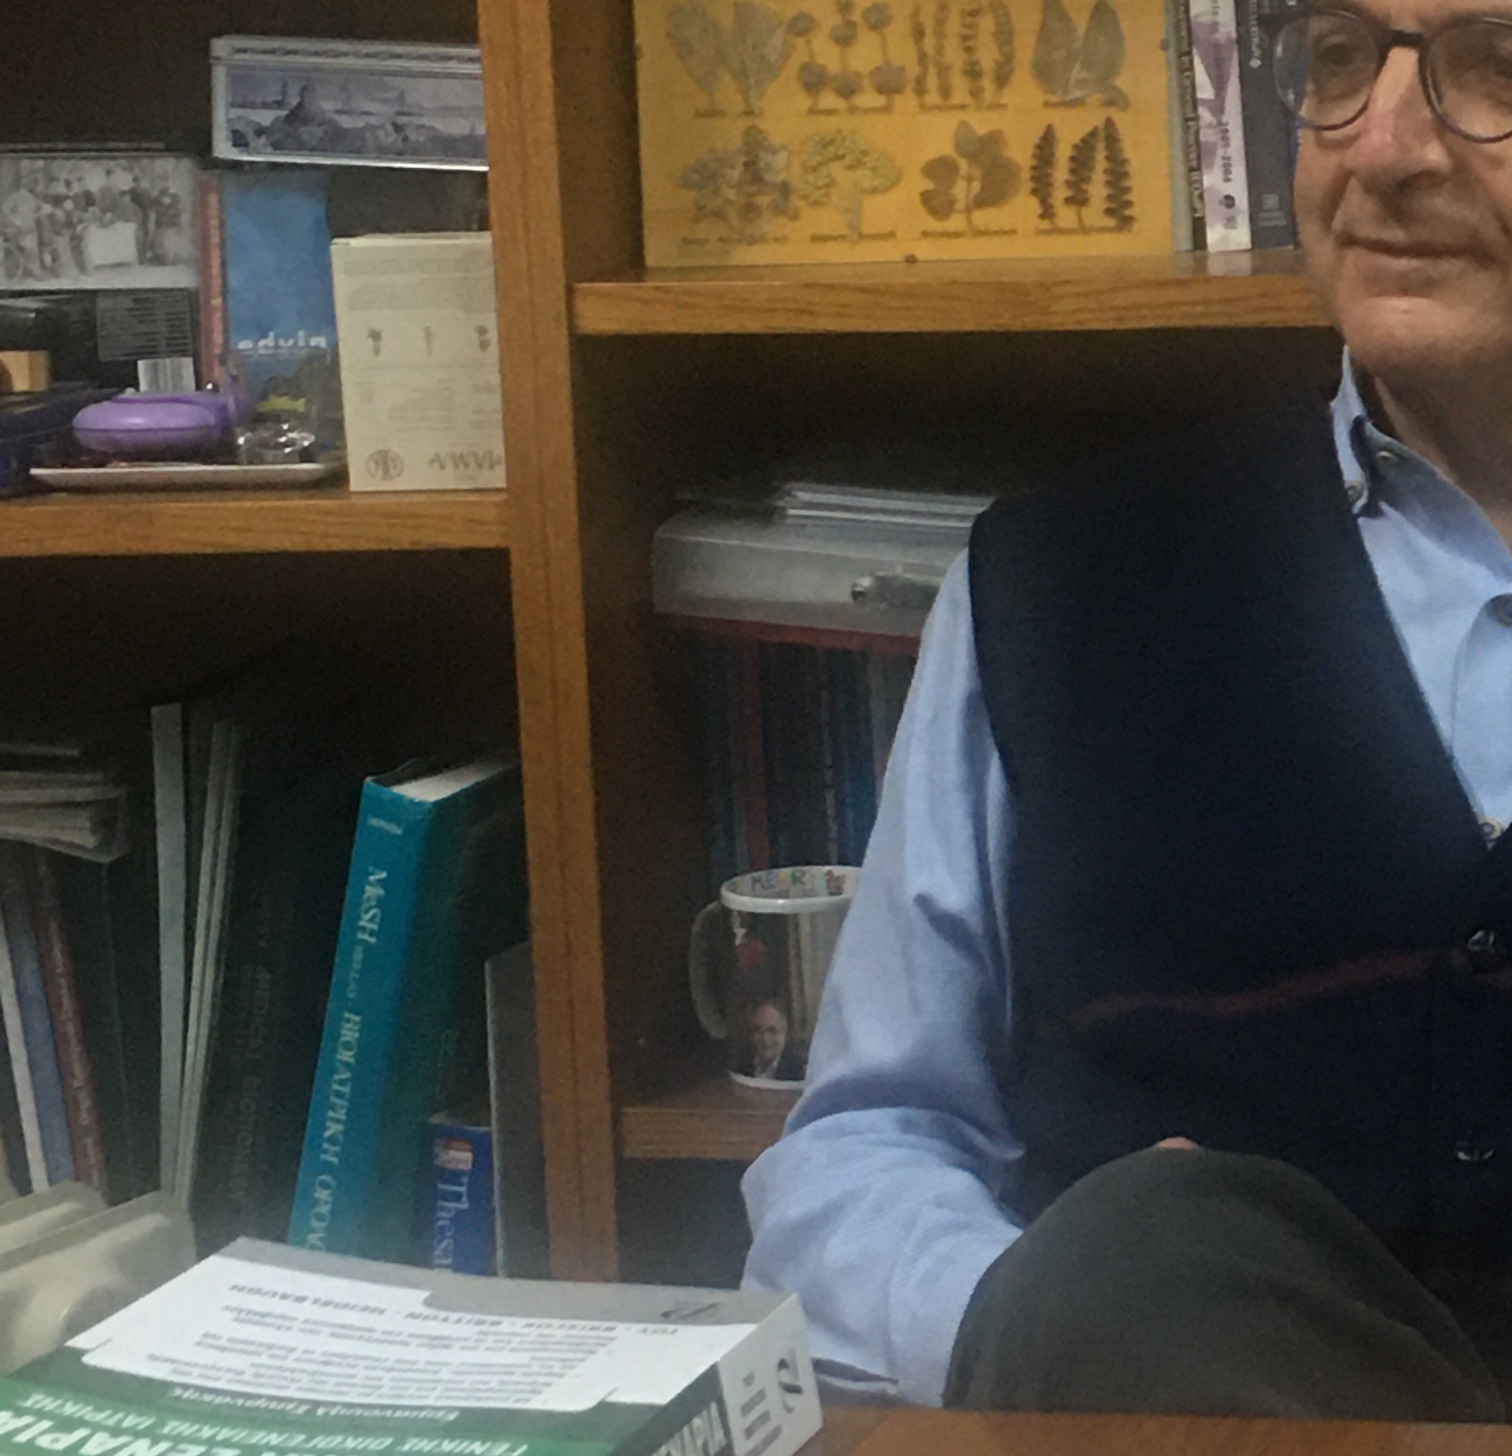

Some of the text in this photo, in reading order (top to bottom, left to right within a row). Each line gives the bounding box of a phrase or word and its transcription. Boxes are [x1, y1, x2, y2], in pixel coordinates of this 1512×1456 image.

[356, 866, 388, 945] MeSH
[345, 945, 364, 999] HELLAS
[319, 1011, 362, 1165] ΒΙΟΙΑΤΡΙΚΗ
[228, 1284, 387, 1316] HEIDELBAUGH
[16, 1392, 528, 1456] ΓΕΝΙΚΗΣ ΟΙΚΟΓΕΝΕΙΑΚΗΣ ΙΑΤΡΙΚΗΣ
